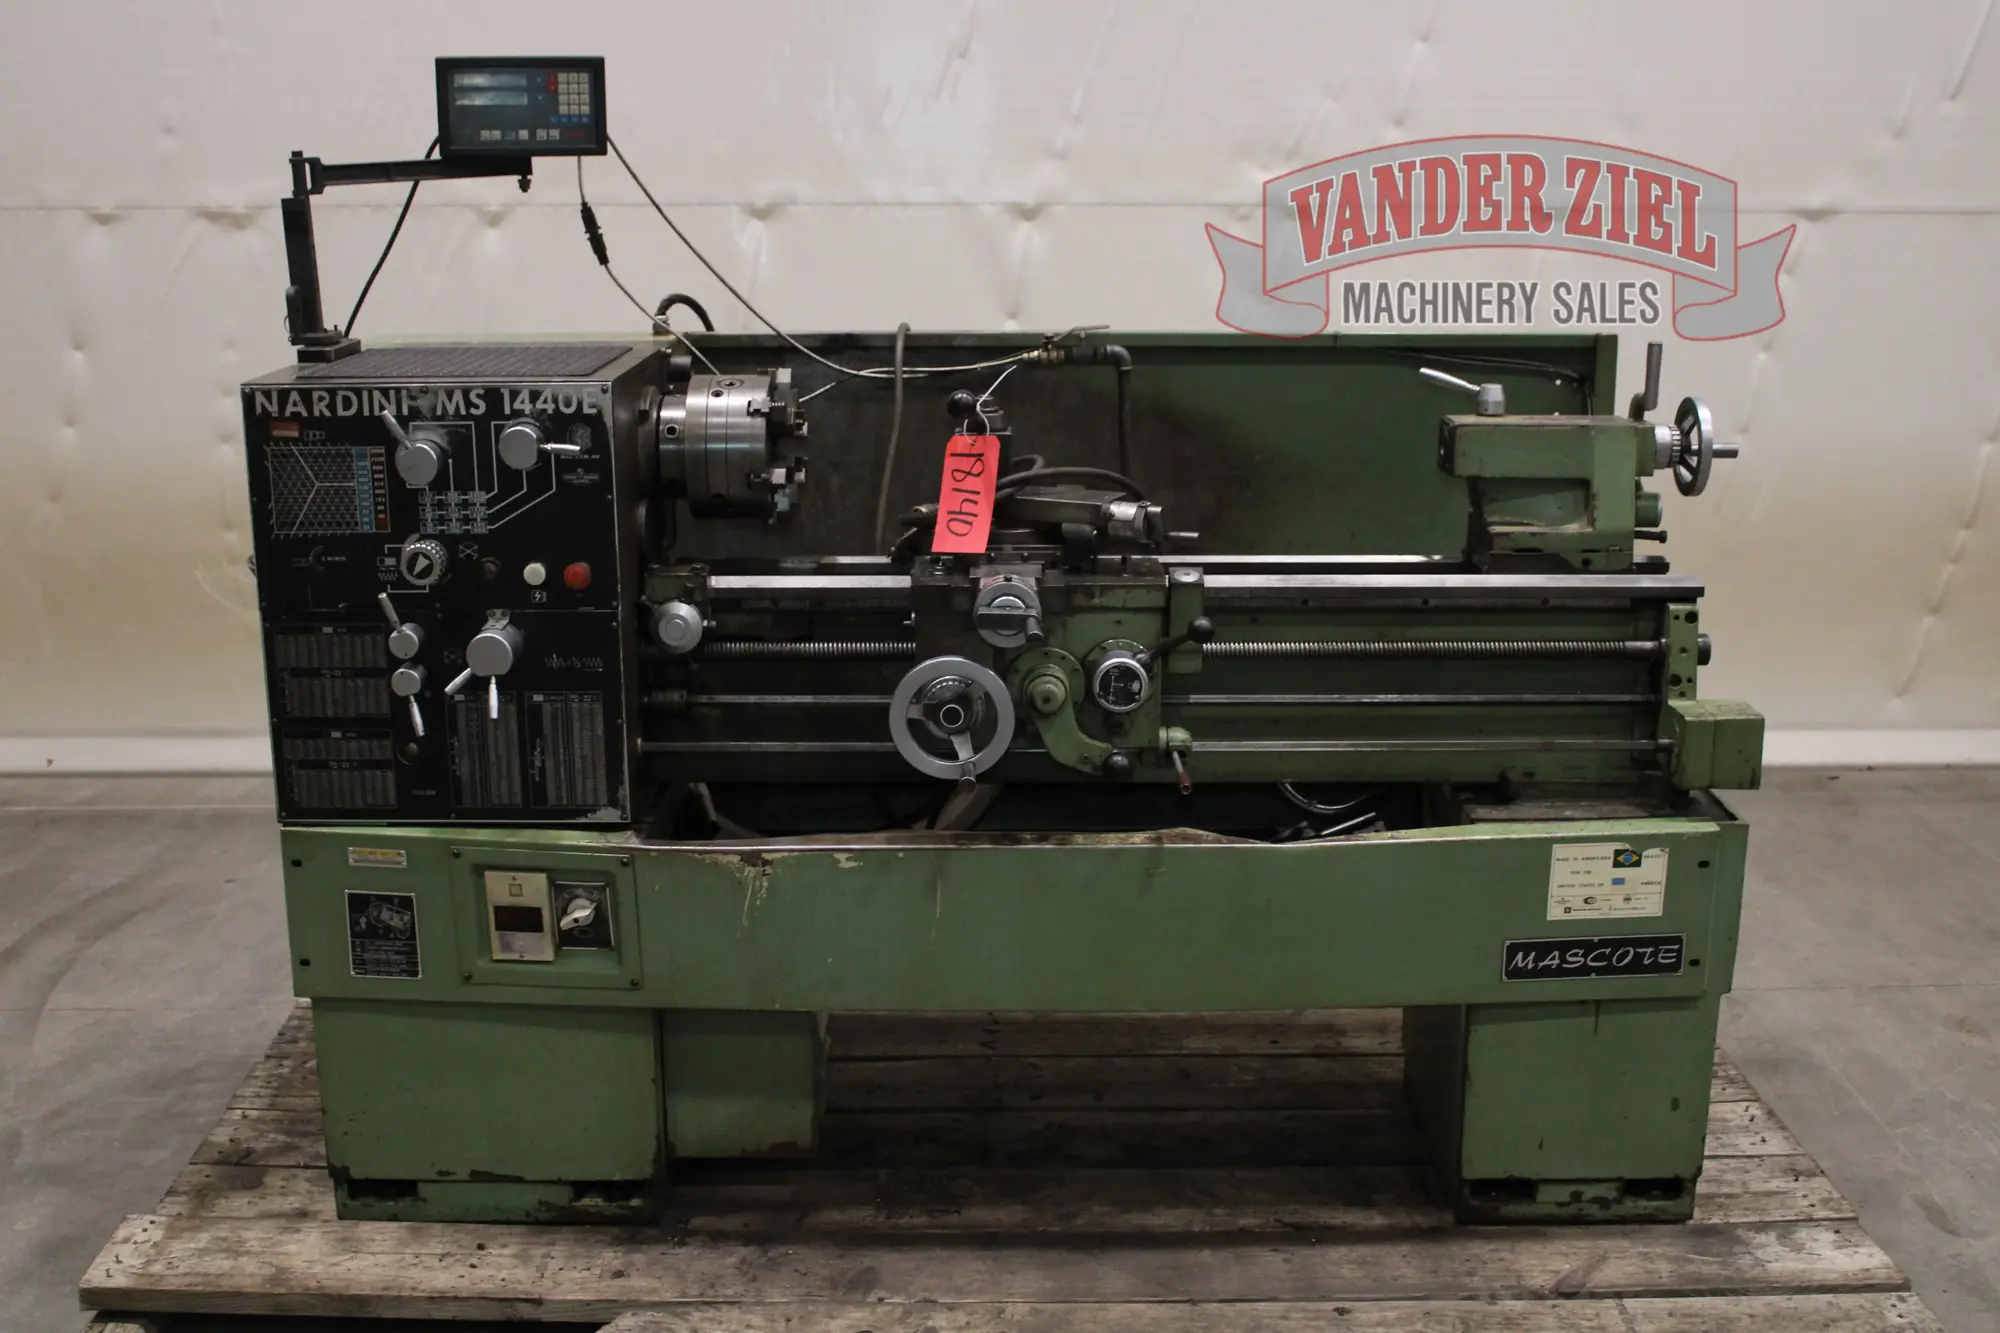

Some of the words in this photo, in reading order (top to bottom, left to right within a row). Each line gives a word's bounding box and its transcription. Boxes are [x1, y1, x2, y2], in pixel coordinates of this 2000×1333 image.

[255, 389, 409, 417] NARDINI
[435, 388, 487, 416] MS
[502, 387, 599, 415] 1440E
[947, 452, 985, 537] 18140
[1508, 944, 1680, 971] MASCOTE
